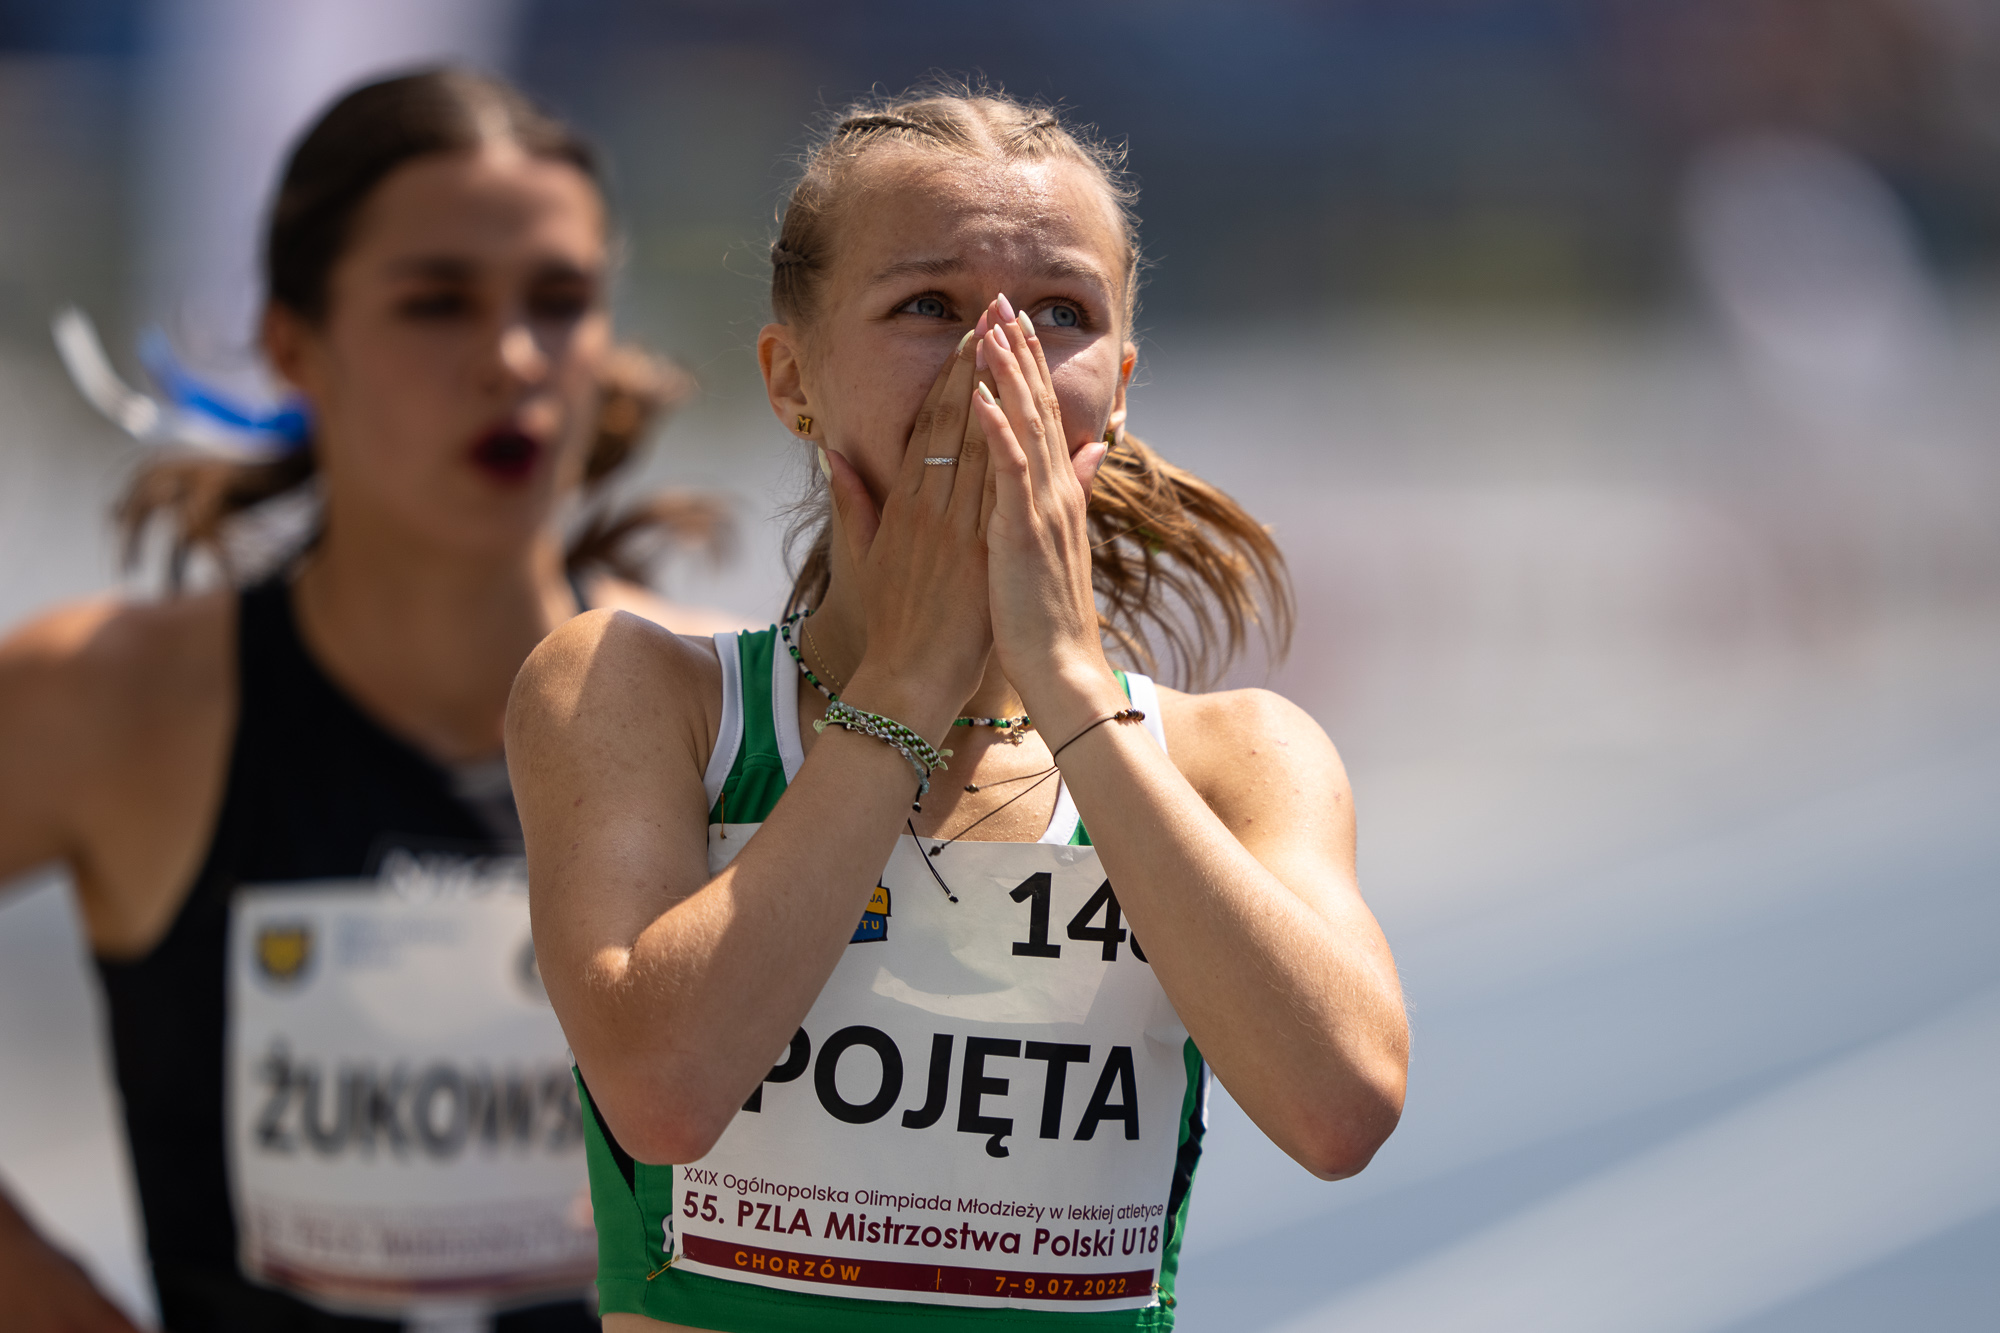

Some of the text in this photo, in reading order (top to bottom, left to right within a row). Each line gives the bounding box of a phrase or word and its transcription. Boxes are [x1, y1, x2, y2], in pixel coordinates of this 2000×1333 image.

[870, 893, 884, 905] JA
[856, 920, 880, 931] TU
[683, 1166, 1164, 1225] XXIX Ogólnopolska Olimpiada Młodzieży w lekkiej atletyce
[682, 1190, 1160, 1257] 55. PZLA Mistrzostwa Polski U18
[734, 1251, 1127, 1296] CHORZÓW 7-9.07.2022
